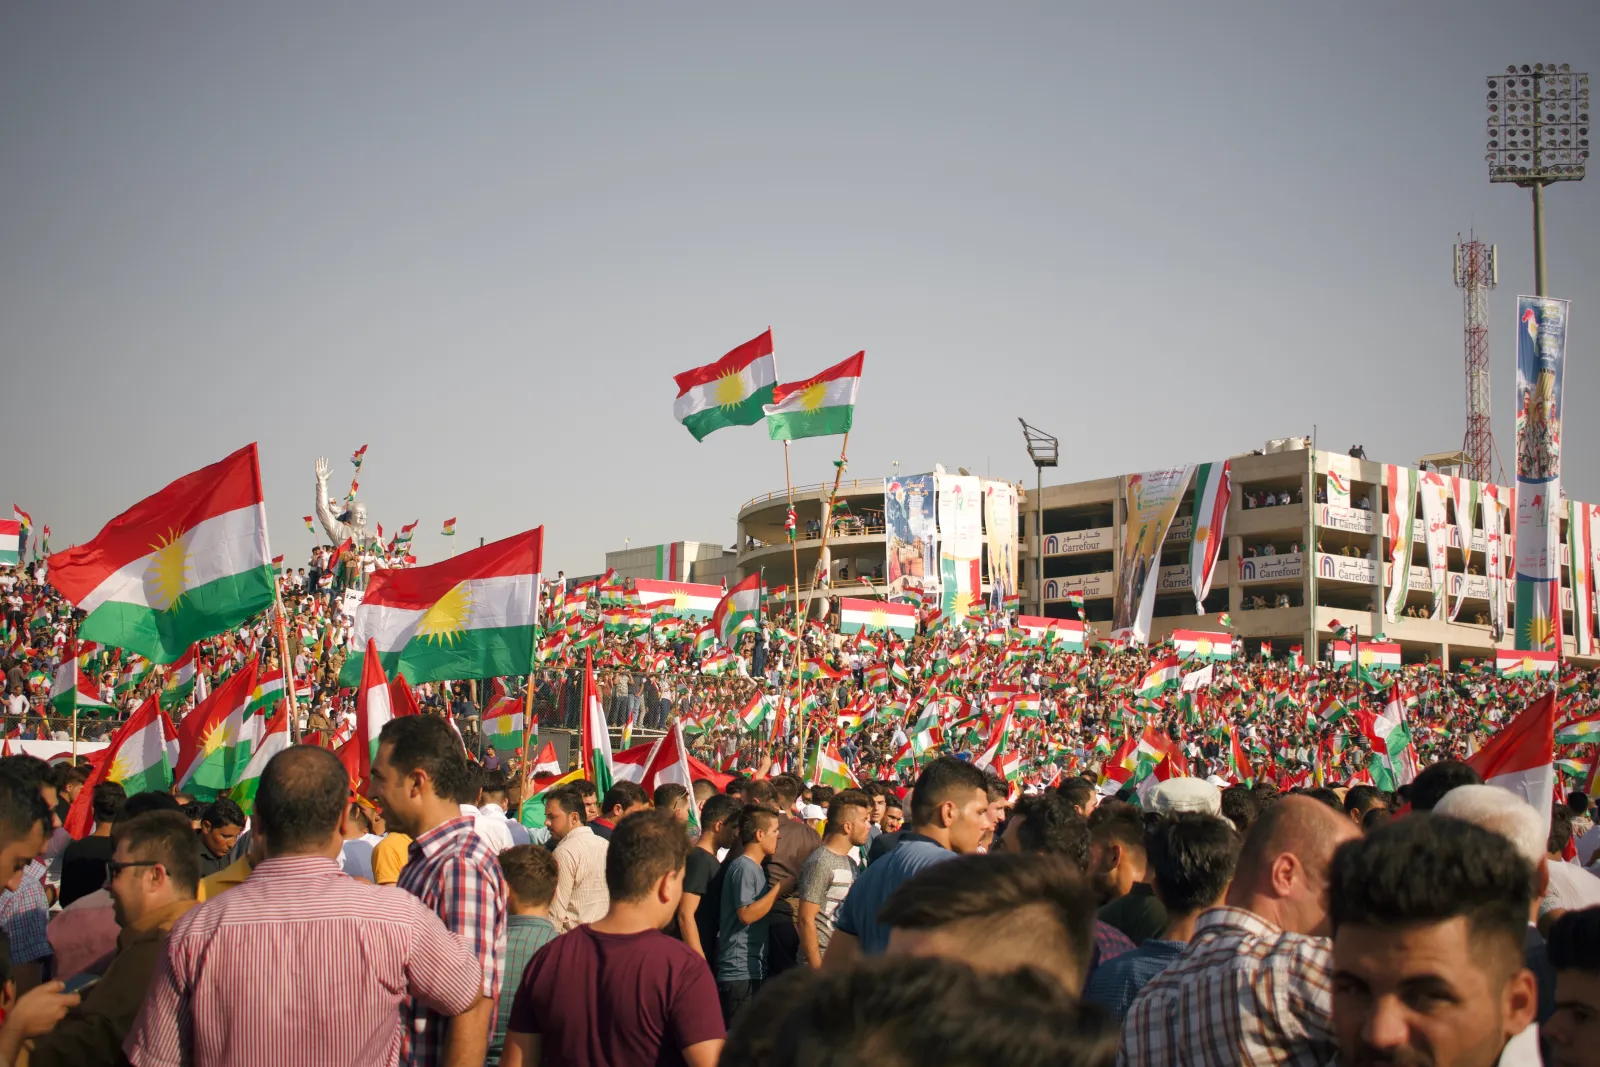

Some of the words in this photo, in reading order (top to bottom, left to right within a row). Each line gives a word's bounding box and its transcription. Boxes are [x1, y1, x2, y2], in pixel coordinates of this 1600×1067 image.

[1339, 518, 1372, 533] Carrefour
[1061, 541, 1101, 553] Carrefour
[1260, 567, 1300, 579] Carrefour
[1338, 569, 1375, 583] Carrefour
[1162, 577, 1192, 589] Carref
[1467, 586, 1490, 598] Carref
